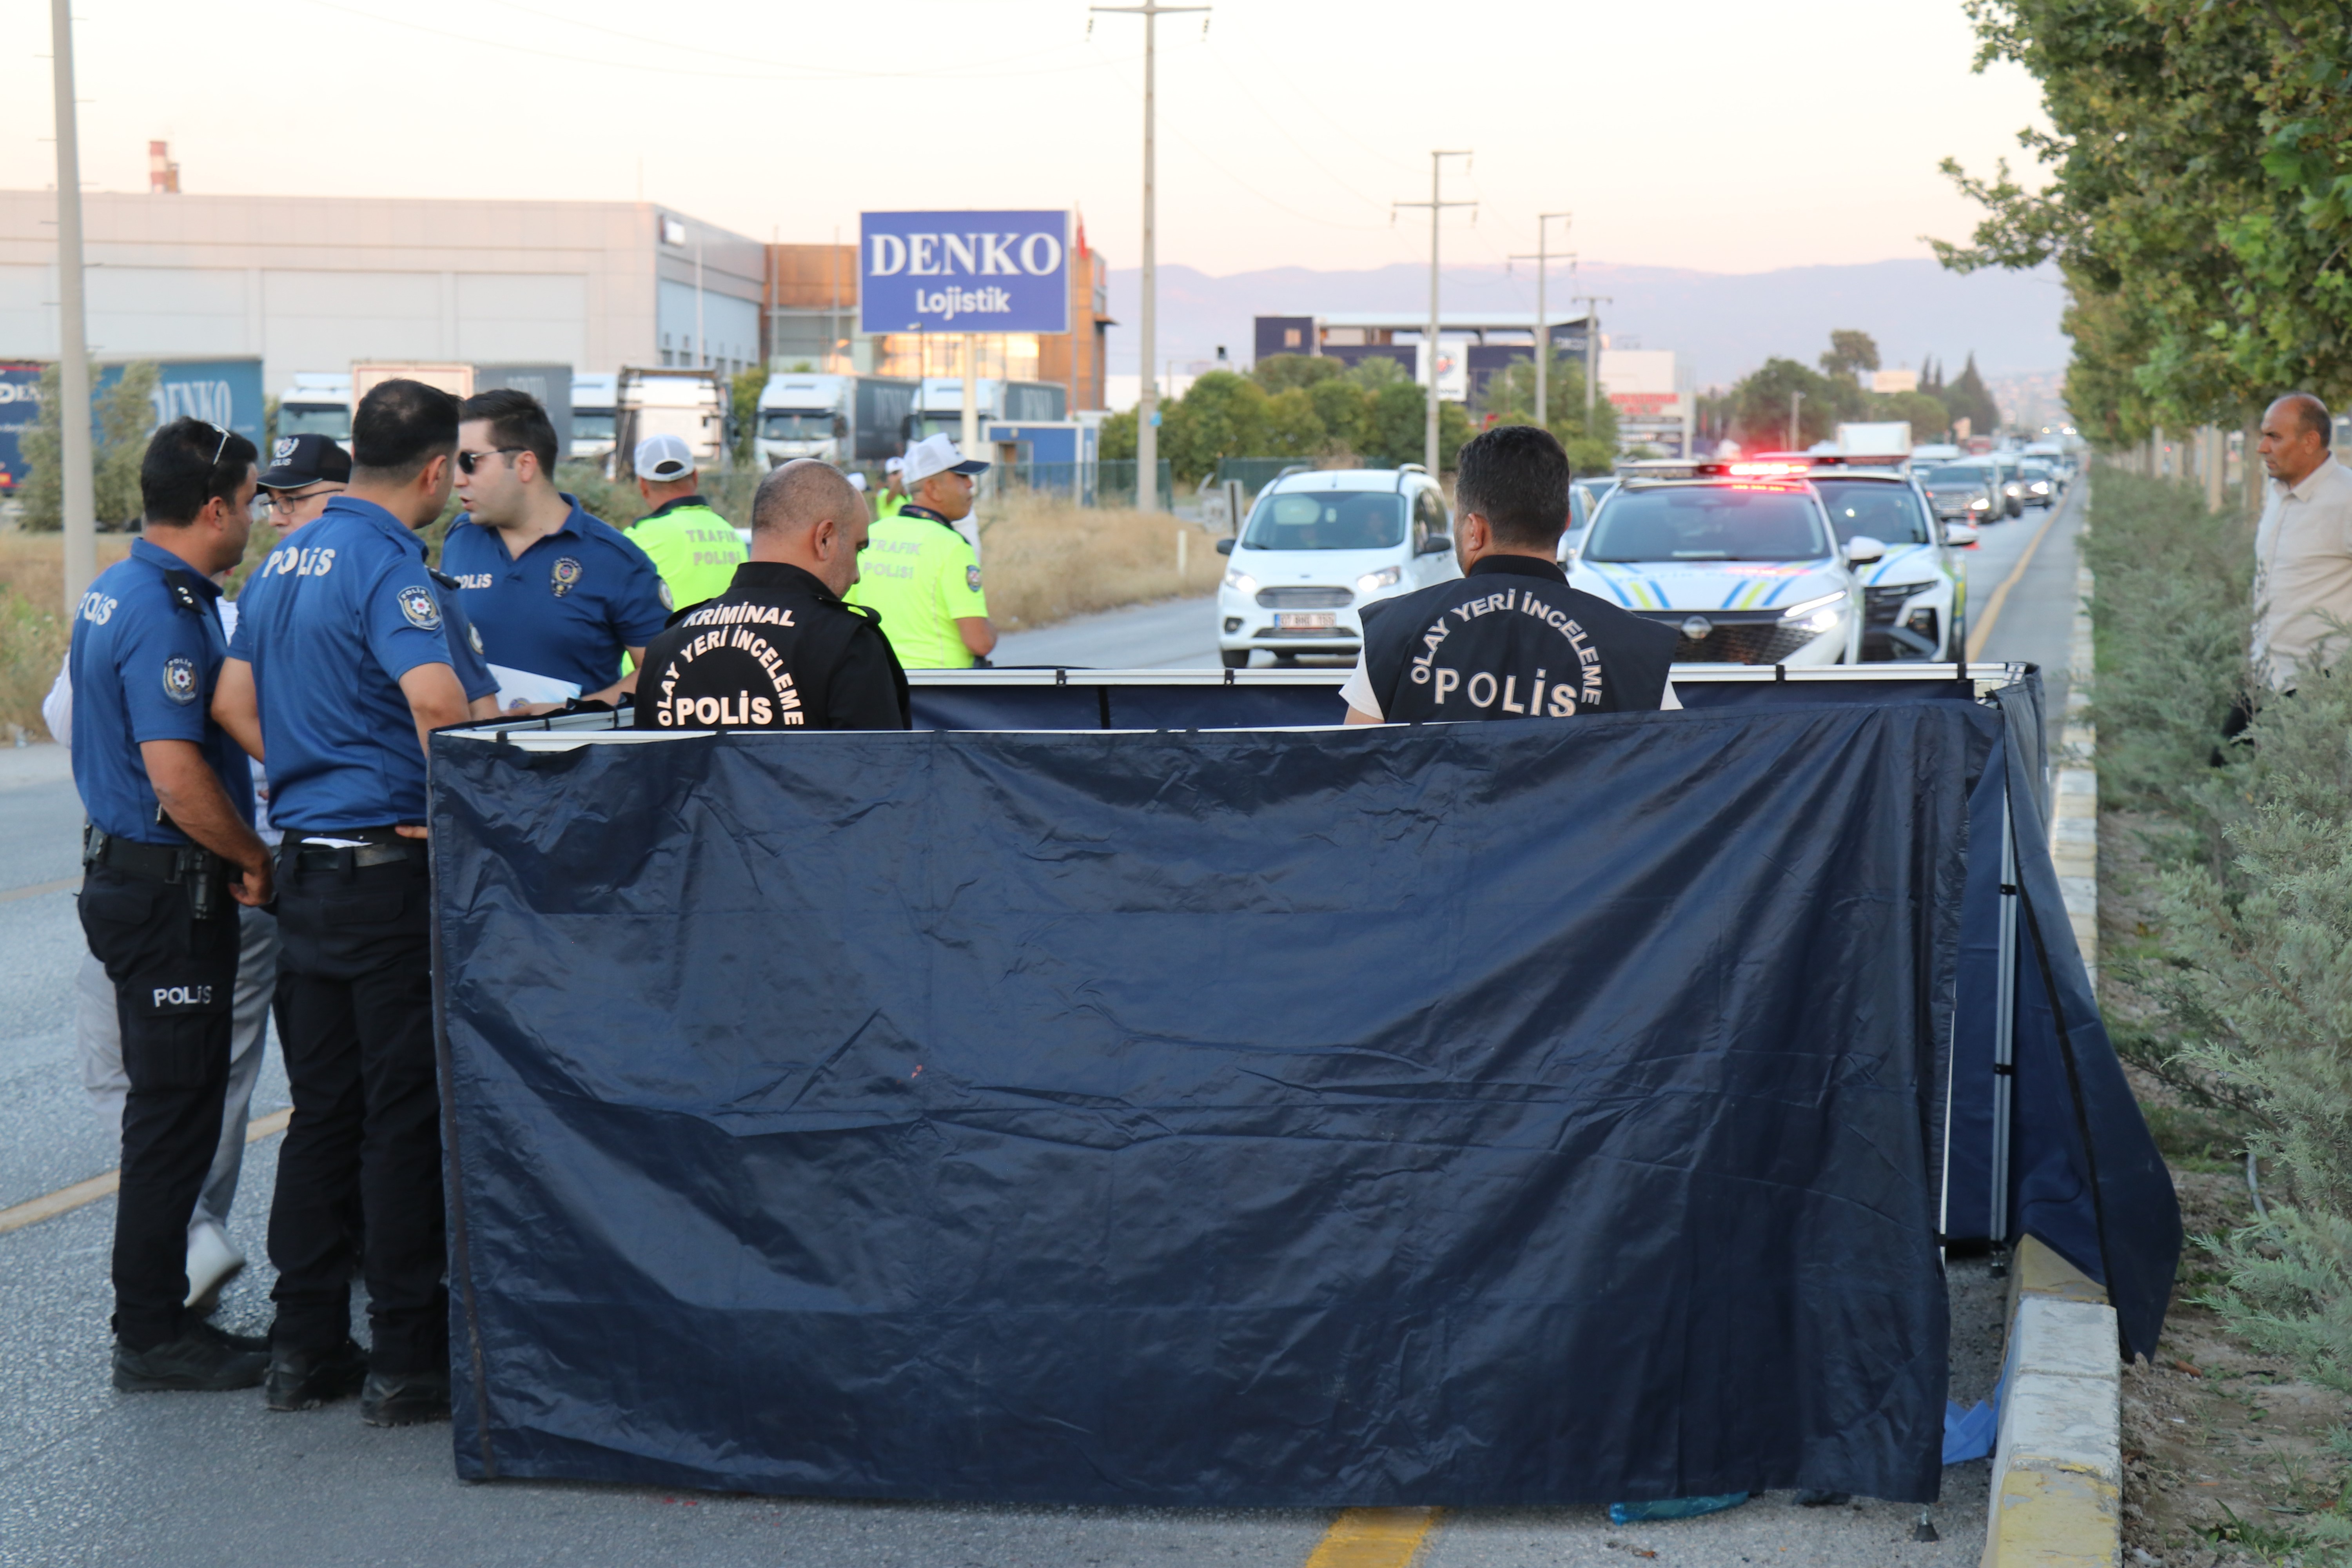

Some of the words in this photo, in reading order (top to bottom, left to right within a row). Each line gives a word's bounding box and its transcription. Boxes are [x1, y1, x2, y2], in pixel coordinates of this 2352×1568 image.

[869, 232, 1062, 276] DENKO
[916, 286, 1012, 321] Lojistik
[682, 601, 795, 628] KRİMİNAL
[1411, 617, 1450, 685] OLAY
[1450, 588, 1516, 622] YERİ
[1521, 591, 1602, 705] İNCELEME
[657, 661, 681, 726] OLAY
[680, 624, 729, 663] YERİ
[731, 624, 804, 725] İNCELEME
[1434, 668, 1578, 717] POLİS
[676, 690, 773, 725] POLİS
